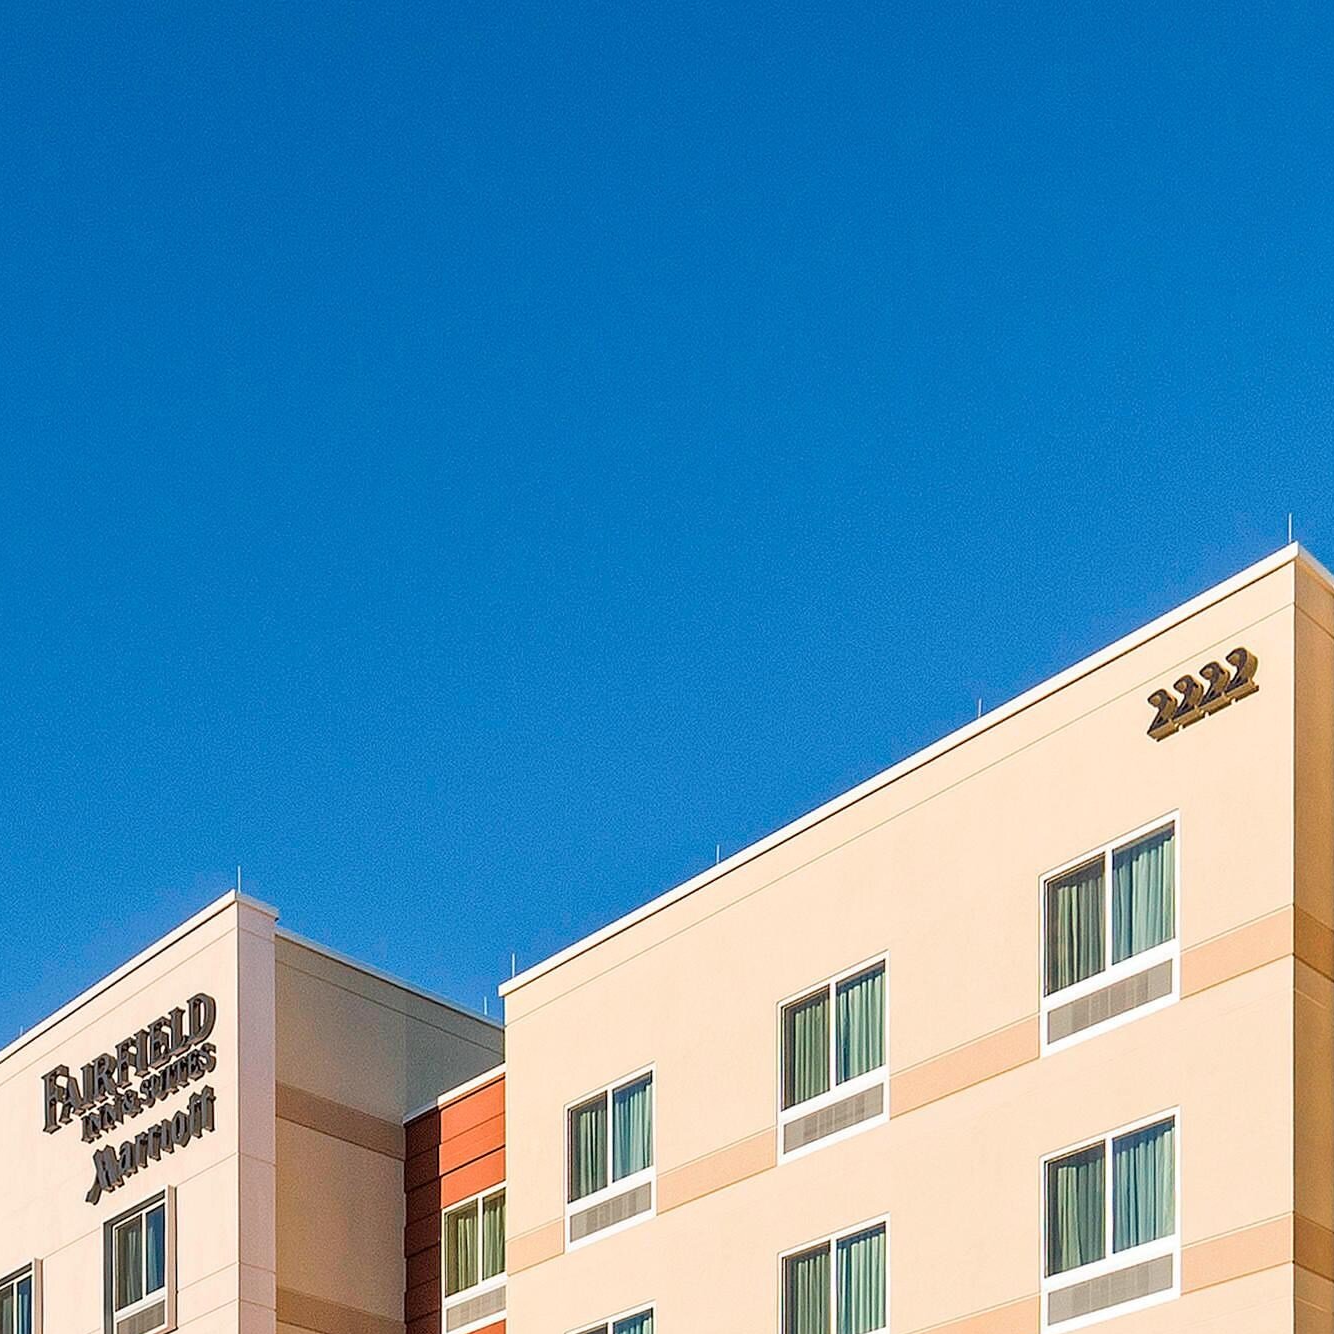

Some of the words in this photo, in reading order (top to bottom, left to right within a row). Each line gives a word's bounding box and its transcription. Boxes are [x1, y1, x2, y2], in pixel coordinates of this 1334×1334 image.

[1147, 648, 1259, 742] 2222
[41, 992, 216, 1134] FAIRFIELD
[81, 1102, 124, 1143] INN
[140, 1042, 217, 1108] SUITES
[85, 1085, 217, 1205] Marriott
